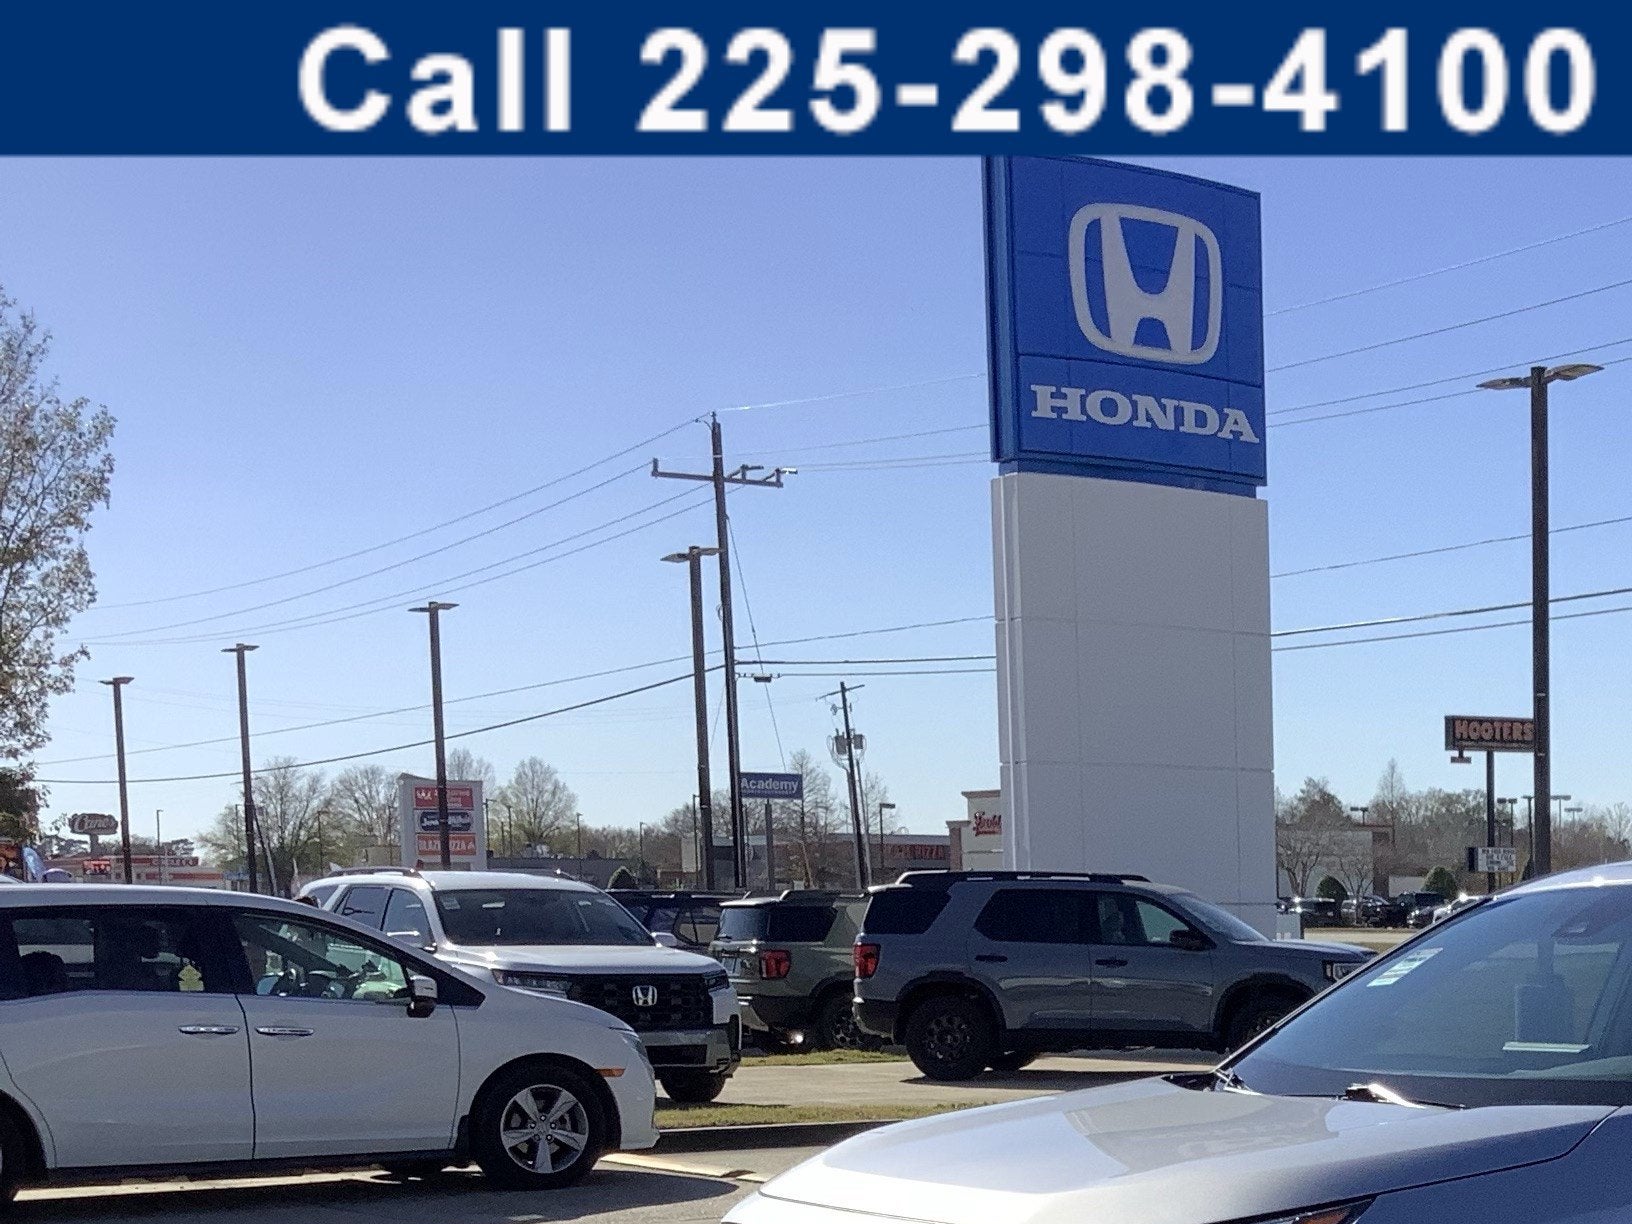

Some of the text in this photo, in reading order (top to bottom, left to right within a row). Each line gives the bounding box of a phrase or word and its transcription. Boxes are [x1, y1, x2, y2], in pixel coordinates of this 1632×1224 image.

[1030, 384, 1260, 443] HONDA
[1454, 720, 1535, 740] HOOTERS
[741, 777, 798, 793] Academy
